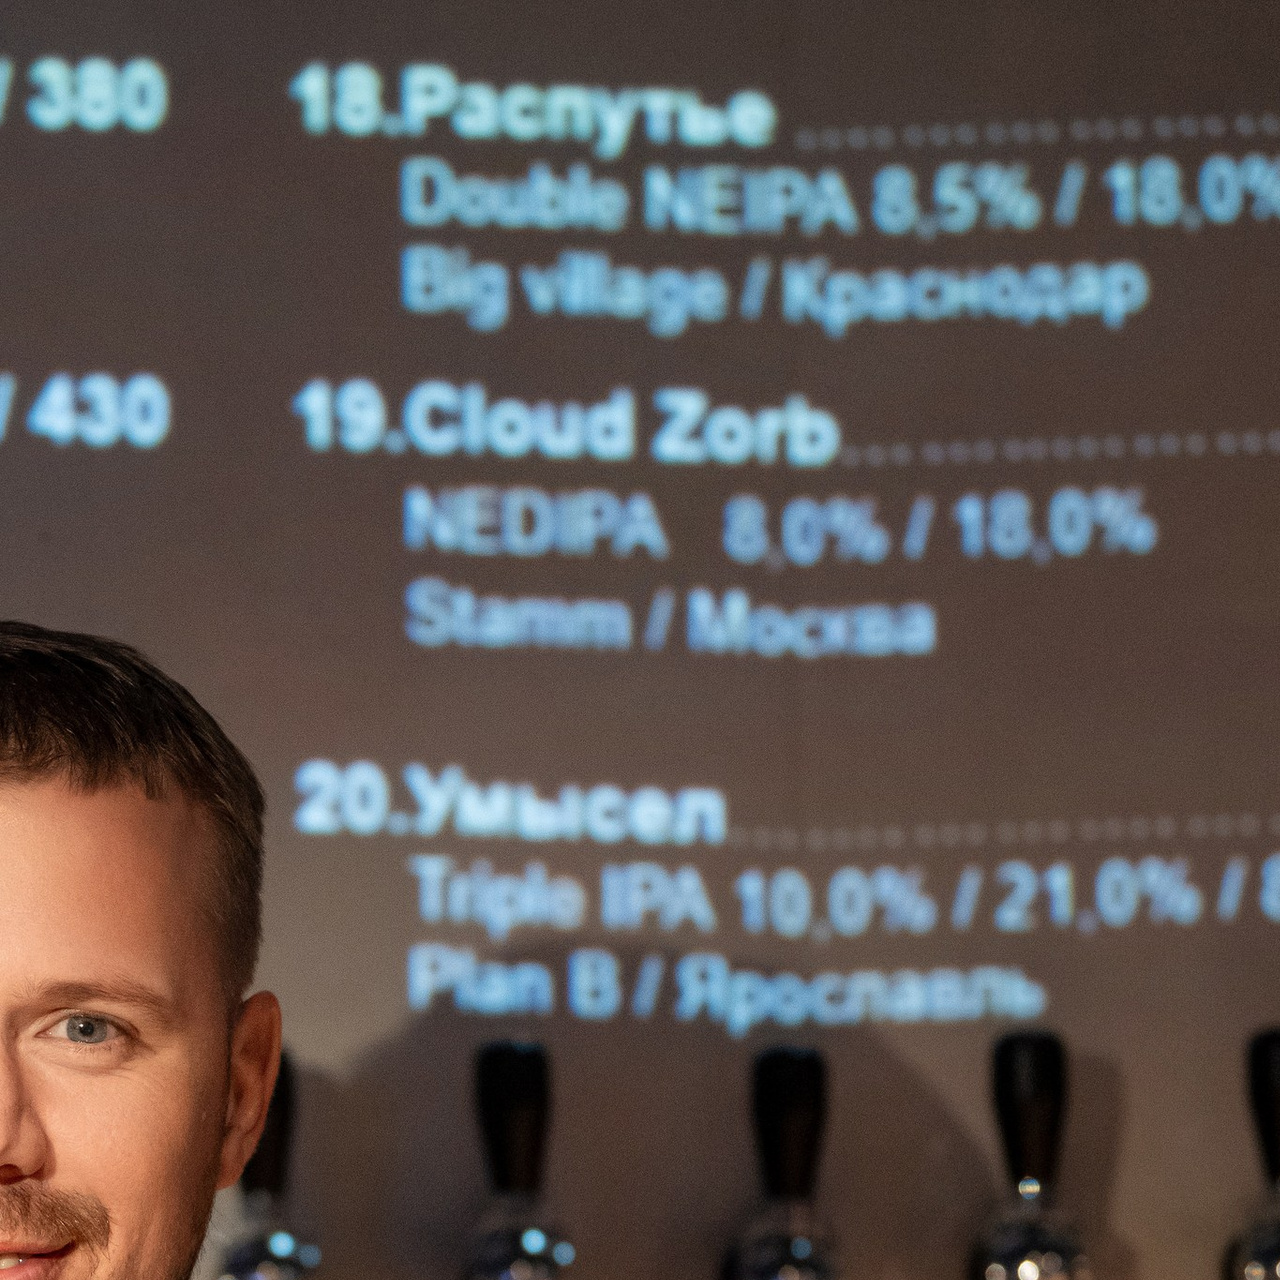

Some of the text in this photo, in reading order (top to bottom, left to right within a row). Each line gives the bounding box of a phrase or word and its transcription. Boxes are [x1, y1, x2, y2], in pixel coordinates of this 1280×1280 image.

[25, 55, 169, 133] 380
[399, 155, 630, 232] Double
[643, 164, 859, 236] NEIPA
[871, 162, 1042, 242] 8,5%
[1054, 163, 1086, 224] /
[400, 243, 1150, 338] Big village / Краснодар
[25, 371, 172, 450] 430
[650, 386, 842, 468] Zorb
[402, 485, 1158, 571] NEDIPA 8,0% / 18,0%
[405, 577, 938, 659] Stamm / Москва
[410, 854, 588, 940] Triple
[599, 861, 717, 933] IPA
[735, 866, 937, 941] 10,0%
[952, 869, 982, 929] /
[994, 856, 1203, 935] 21,0%
[1217, 860, 1246, 920] /
[404, 941, 1052, 1036] Plan B / Ярославль
